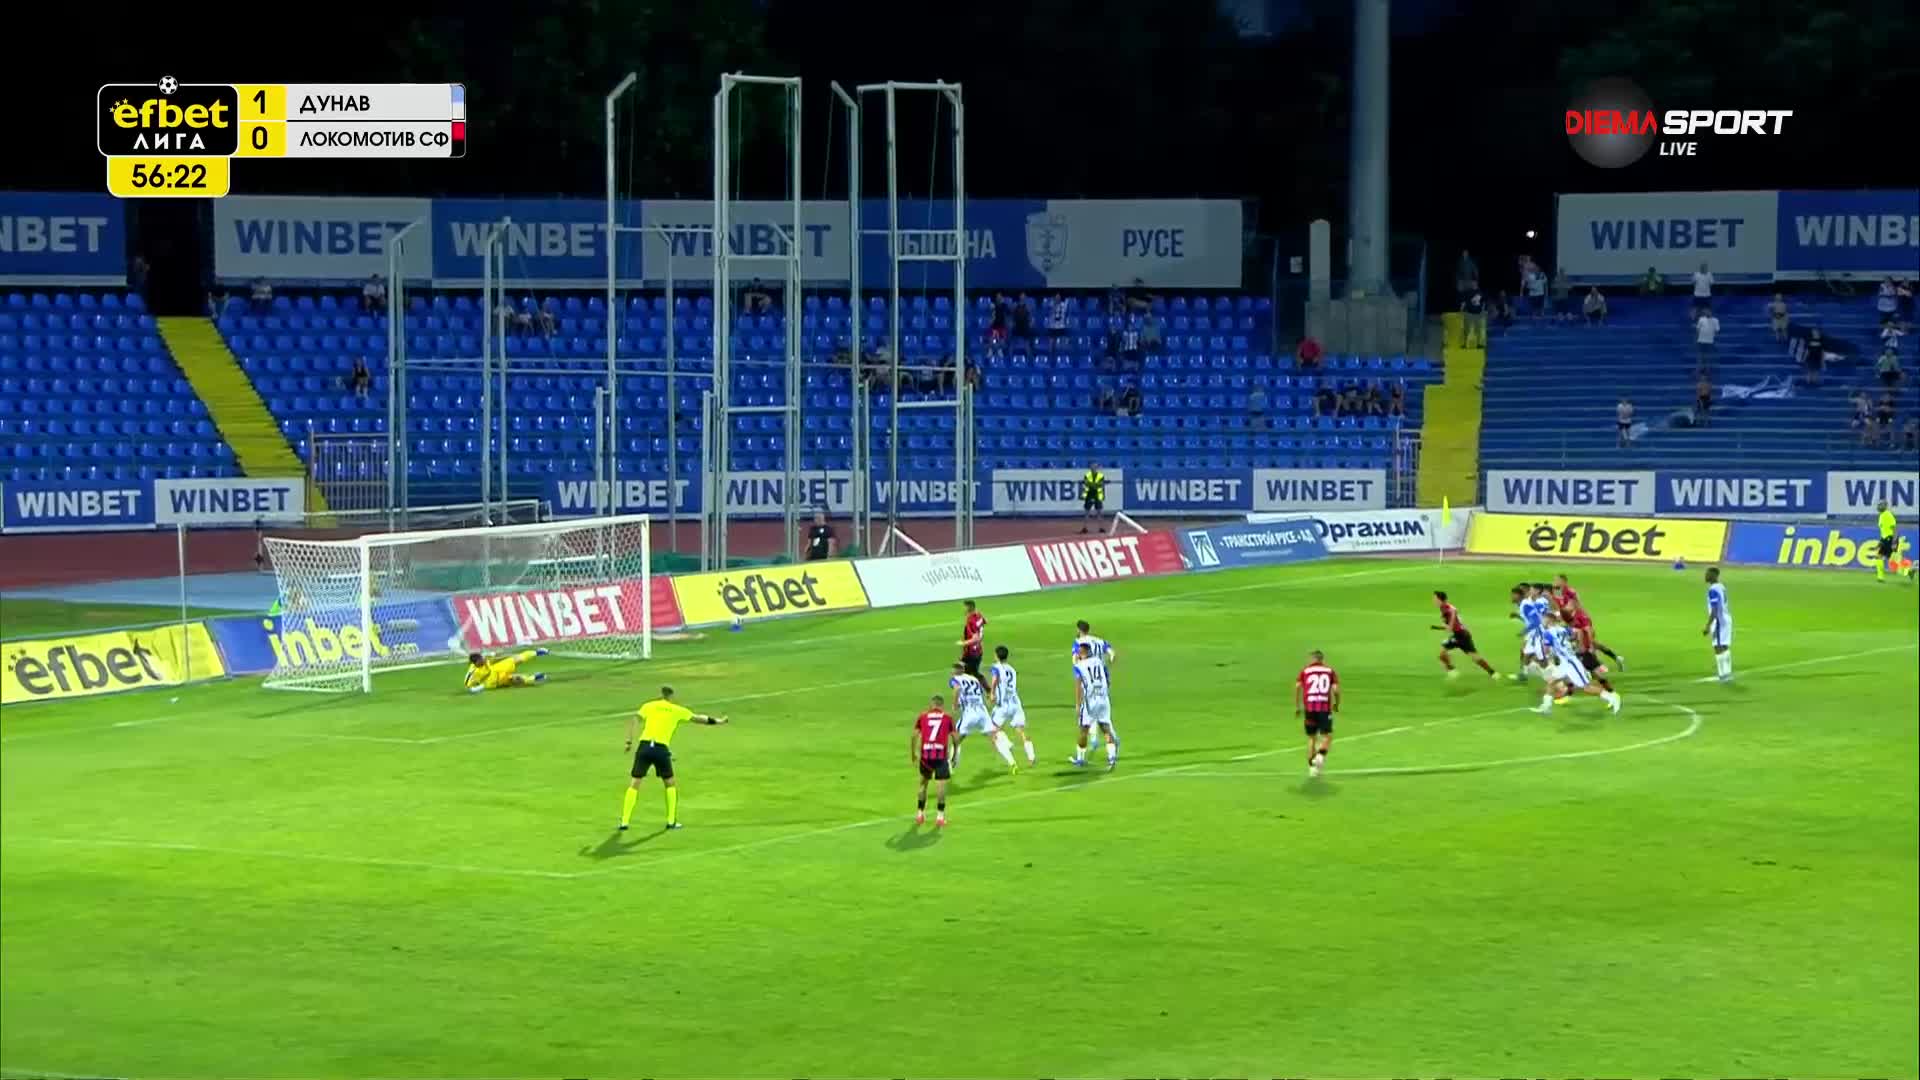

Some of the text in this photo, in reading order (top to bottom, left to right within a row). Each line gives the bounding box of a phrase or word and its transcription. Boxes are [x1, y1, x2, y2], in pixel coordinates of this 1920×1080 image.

[1123, 229, 1184, 258] РУСЕ
[1589, 217, 1745, 251] WINBET
[16, 490, 142, 519] WINBET
[169, 487, 291, 514] WINBET
[1135, 479, 1242, 502] WINBET
[1266, 479, 1374, 502] WINBET
[1502, 478, 1639, 507] WINBET
[1670, 478, 1812, 508] WINBET
[1528, 520, 1666, 557] efbet
[1033, 536, 1146, 583] WINBET
[720, 570, 827, 616] efbet
[466, 585, 628, 646] WINBET
[13, 643, 165, 695] efbet
[1005, 670, 1014, 689] 2
[1305, 673, 1331, 694] 20
[961, 679, 981, 696] 22
[927, 719, 943, 742] 7
